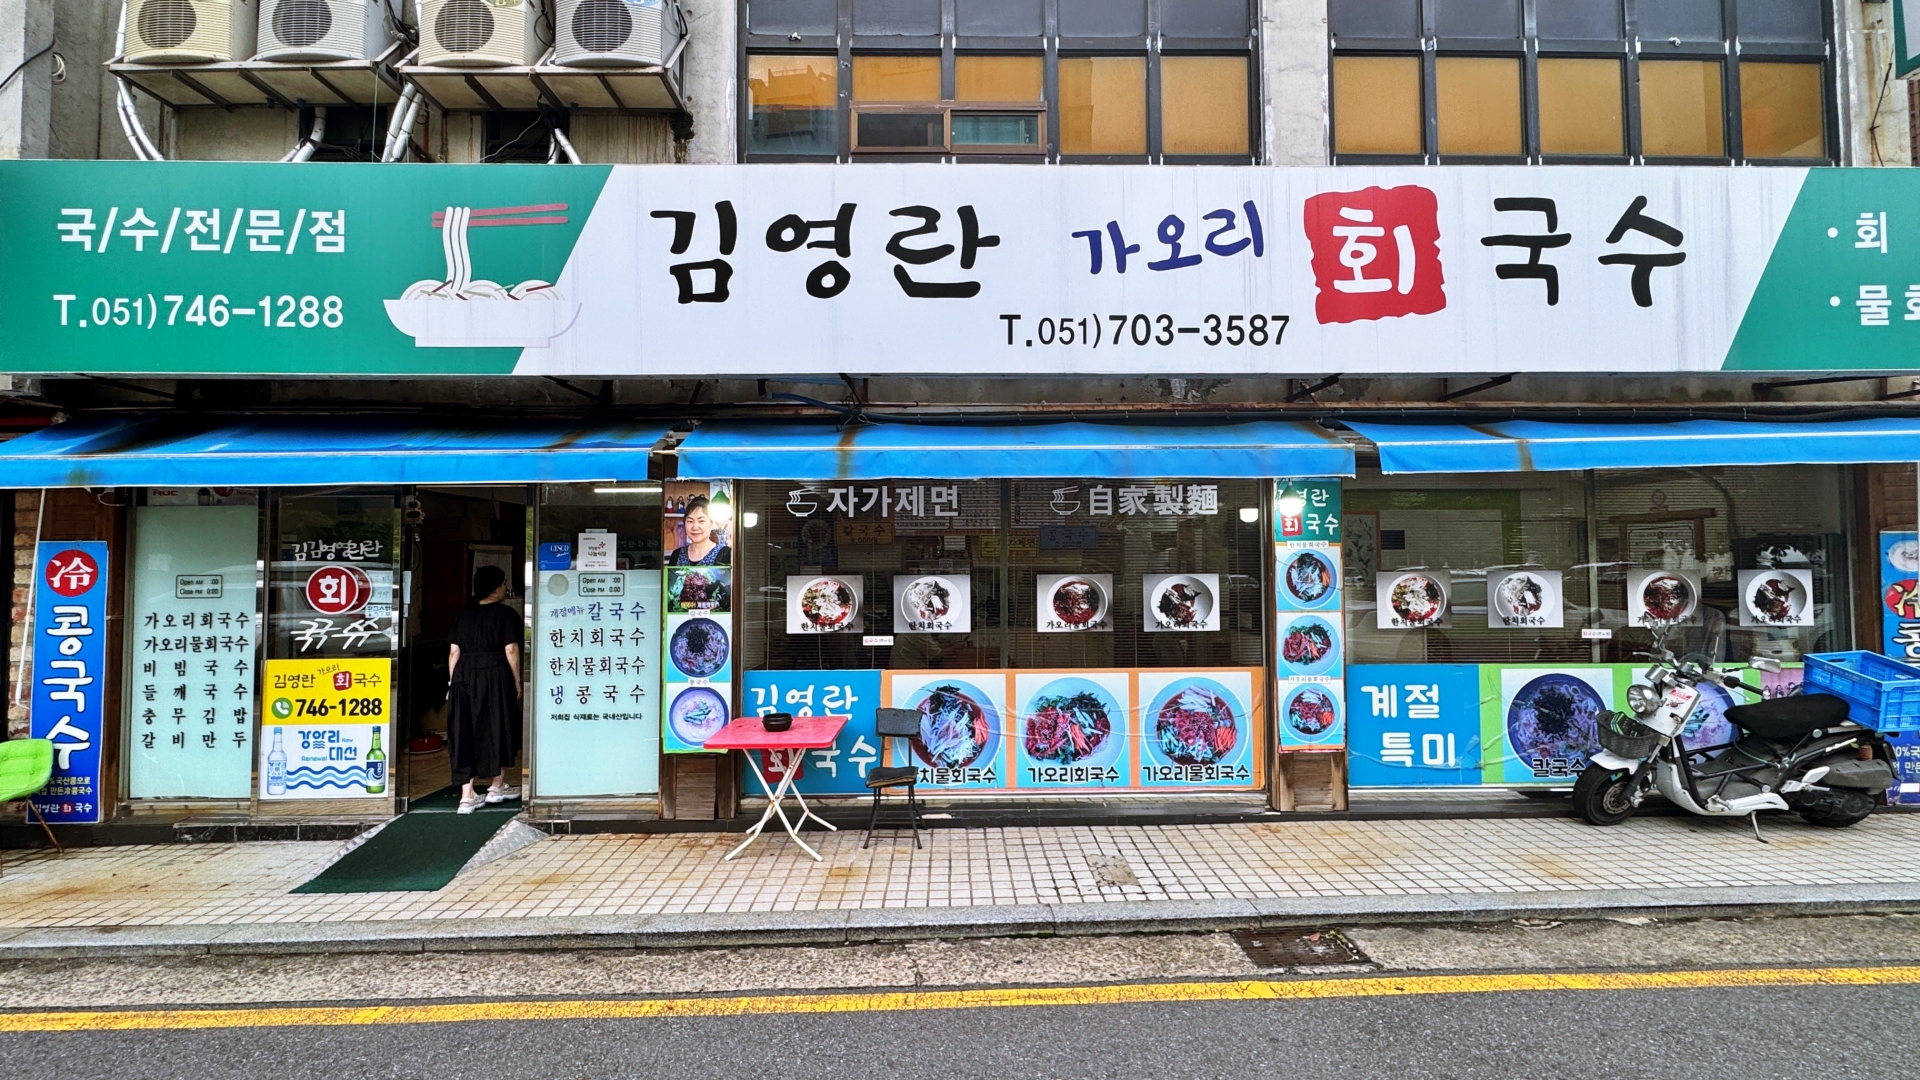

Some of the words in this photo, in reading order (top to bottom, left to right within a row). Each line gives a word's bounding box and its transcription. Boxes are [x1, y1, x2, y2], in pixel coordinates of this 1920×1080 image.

[56, 206, 347, 254] 국/수/전/문/점
[1855, 212, 1888, 254] 회
[650, 200, 1000, 304] 김영란
[1072, 200, 1264, 274] 가오리
[1332, 207, 1417, 295] 회
[1480, 195, 1687, 308] 국수
[53, 294, 345, 329] T.051)746-1288
[1000, 313, 1290, 350] T.051)703-3587
[826, 485, 959, 518] 자가제면
[1278, 488, 1330, 507] 영란
[1306, 513, 1339, 536] 국수
[550, 544, 569, 552] CESCO
[50, 557, 94, 590] 冷
[179, 578, 194, 586] Open
[318, 574, 347, 606] 회
[144, 612, 250, 630] 가오리회국수
[550, 605, 585, 619] 계절메뉴
[588, 601, 646, 621] 칼국수
[143, 635, 249, 653] 가오리물회국수
[549, 627, 646, 648] 한치회국수
[316, 662, 340, 675] 가오리
[549, 656, 646, 676] 한치물회국수
[43, 605, 94, 770] 콩국수
[273, 673, 316, 689] 김영란
[335, 673, 350, 688] 회
[353, 673, 382, 688] 국수
[295, 697, 382, 717] 746-1288
[750, 684, 859, 720] 김영란
[1361, 684, 1440, 719] 계절
[329, 746, 358, 761] 대선
[811, 735, 877, 778] 국수
[1380, 732, 1456, 767] 특미
[918, 767, 997, 785] 치물회국수
[1027, 766, 1120, 784] 가오리회국수
[1142, 765, 1250, 782] 가오리물회국수
[1533, 757, 1586, 778] 칼국수
[63, 803, 72, 813] 회
[75, 802, 93, 813] 국수
